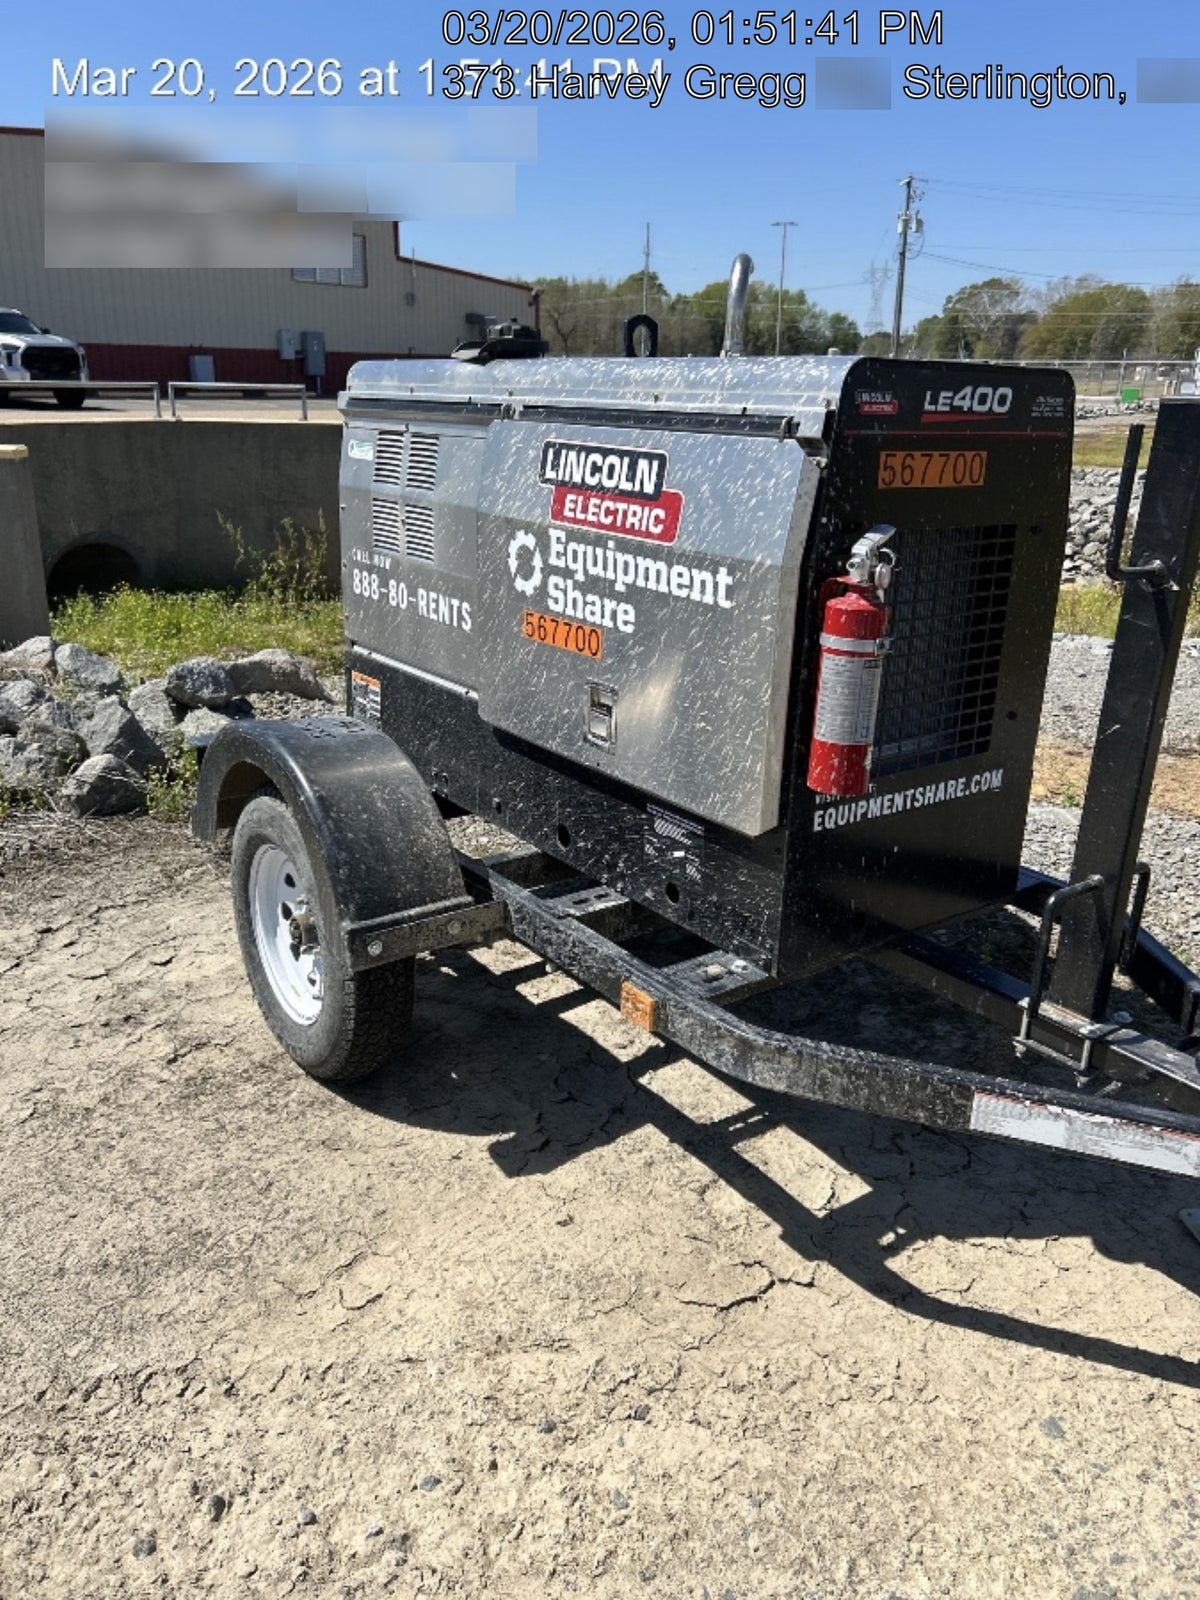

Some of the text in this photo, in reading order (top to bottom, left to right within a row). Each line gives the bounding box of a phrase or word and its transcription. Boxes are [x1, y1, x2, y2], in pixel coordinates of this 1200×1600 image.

[923, 385, 1013, 414] LE400
[545, 447, 660, 495] LINCOLN
[881, 452, 985, 486] 567700
[563, 493, 666, 534] ELECTRIC
[548, 528, 734, 609] Equipment
[353, 568, 472, 633] 888-80-RENTS
[547, 574, 636, 634] Share
[525, 612, 600, 657] 567700
[813, 768, 1004, 832] EQUIPMENTSHARE.COM
